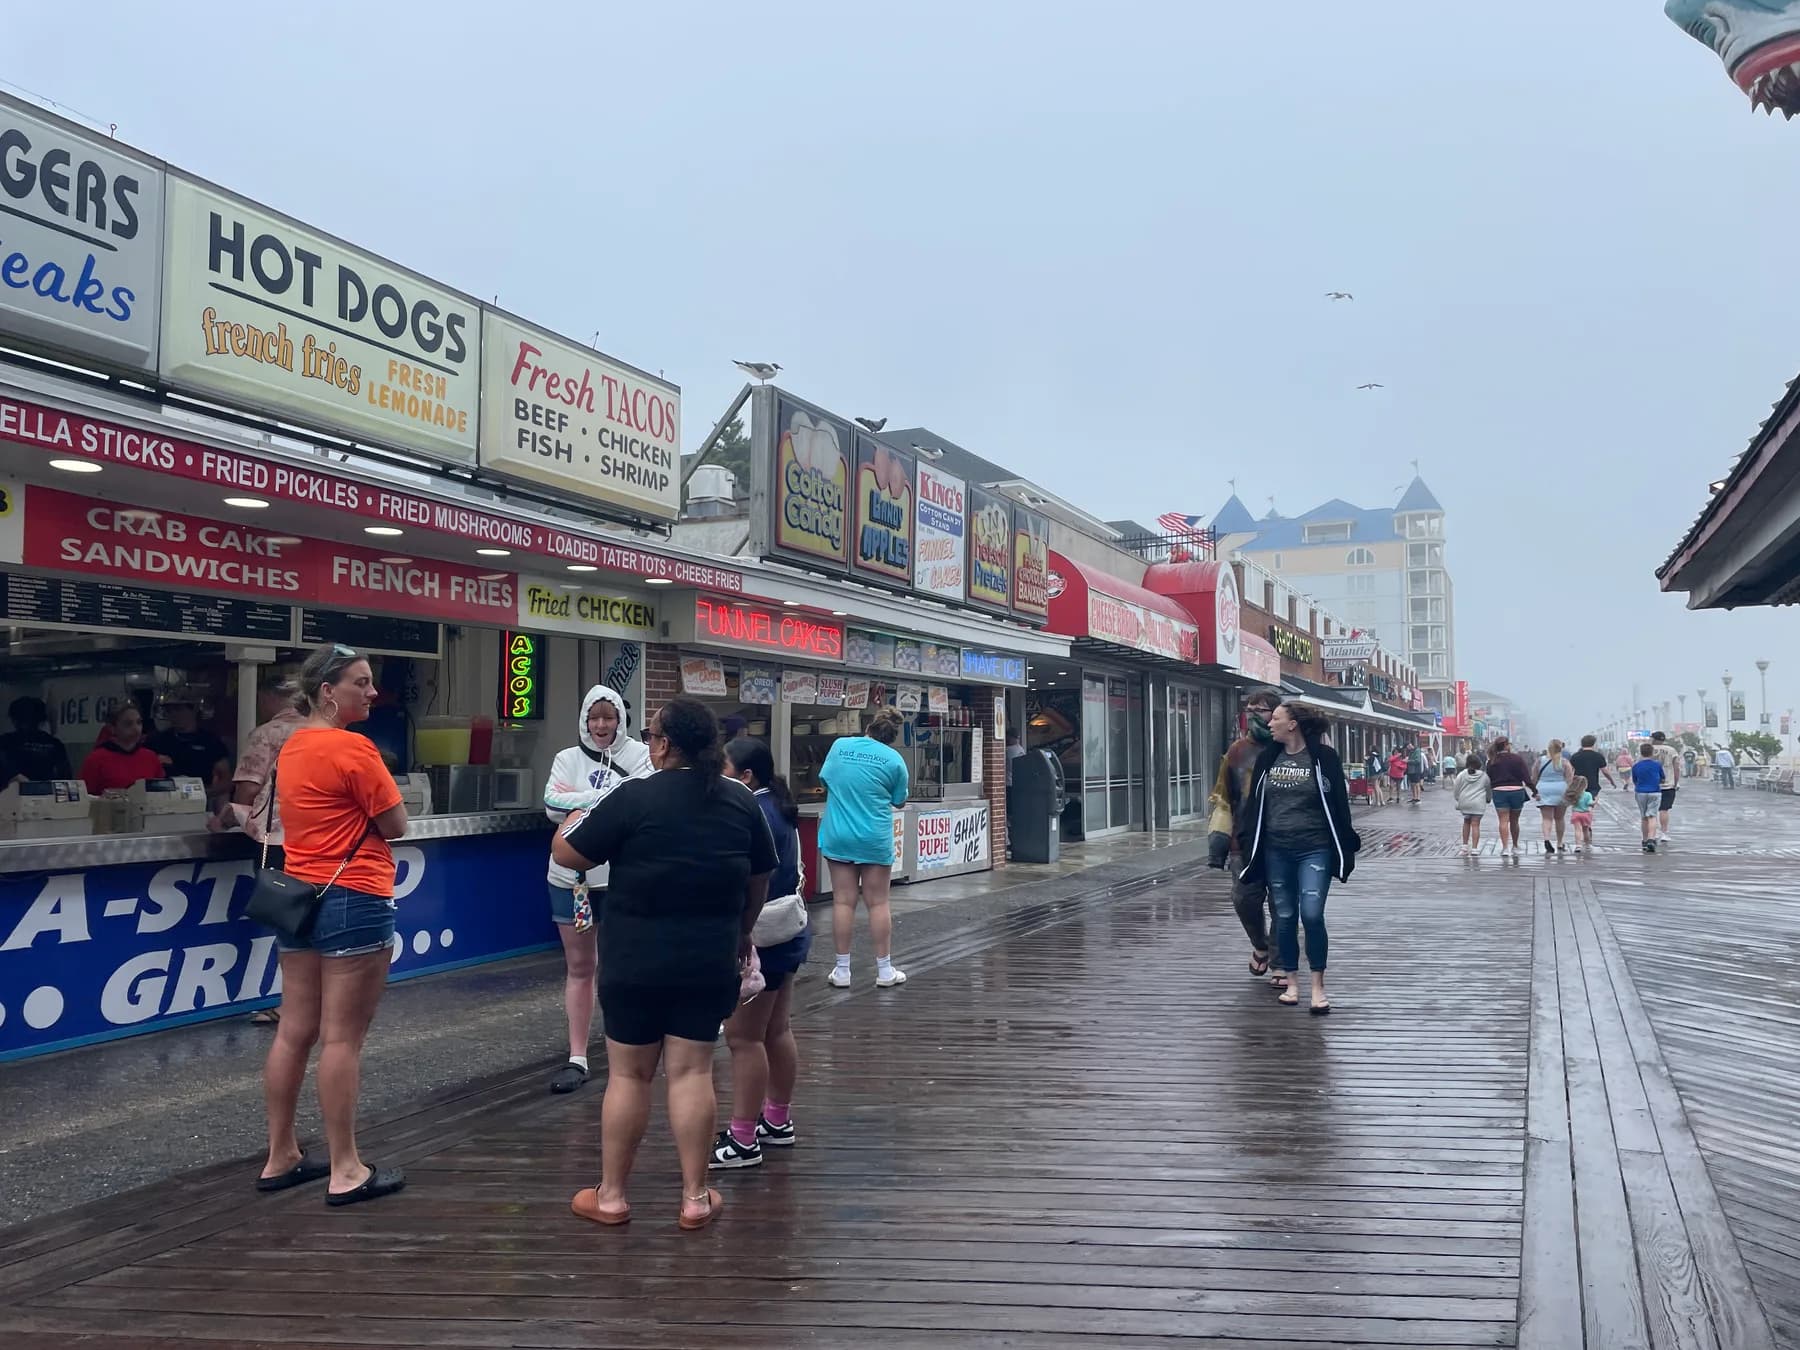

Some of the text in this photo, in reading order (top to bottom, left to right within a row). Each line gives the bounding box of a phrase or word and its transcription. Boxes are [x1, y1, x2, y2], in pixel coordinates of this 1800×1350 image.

[0, 128, 139, 240] GERS
[1, 253, 136, 322] eaks
[208, 211, 466, 363] HOT DOGS
[202, 307, 361, 396] french fries
[388, 359, 447, 400] FRESH
[511, 341, 676, 443] Fresh TACOS
[368, 381, 468, 433] LEMONADE
[514, 398, 672, 469] BEEF CHICKEN
[517, 428, 669, 493] FISH SHRIMP
[785, 460, 842, 511] Cotton
[0, 404, 740, 591] ELLA STICKS FRIED PICKLES FRIED MUSHROOMS LOADED TATER TOTS CHEESE FRIES
[920, 471, 963, 513] KING'S
[87, 507, 282, 558] CRAB CAKE
[785, 494, 841, 550] Candy
[860, 525, 908, 569] APPLES
[931, 516, 950, 531] STAND
[60, 538, 299, 591] SANDWICHES
[333, 555, 513, 609] FRENCH FRIES
[527, 585, 655, 628] Fried CHICKEN
[697, 600, 841, 656] FUNNEL CAKES
[1003, 657, 1022, 681] ICE
[1326, 646, 1370, 658] Atlantic
[820, 678, 843, 689] SLUSH
[1269, 767, 1311, 777] BALTIMORE
[918, 818, 951, 836] SLUSH
[954, 808, 987, 845] SHAVE
[963, 838, 979, 863] ICE
[101, 936, 283, 1025] GRI
